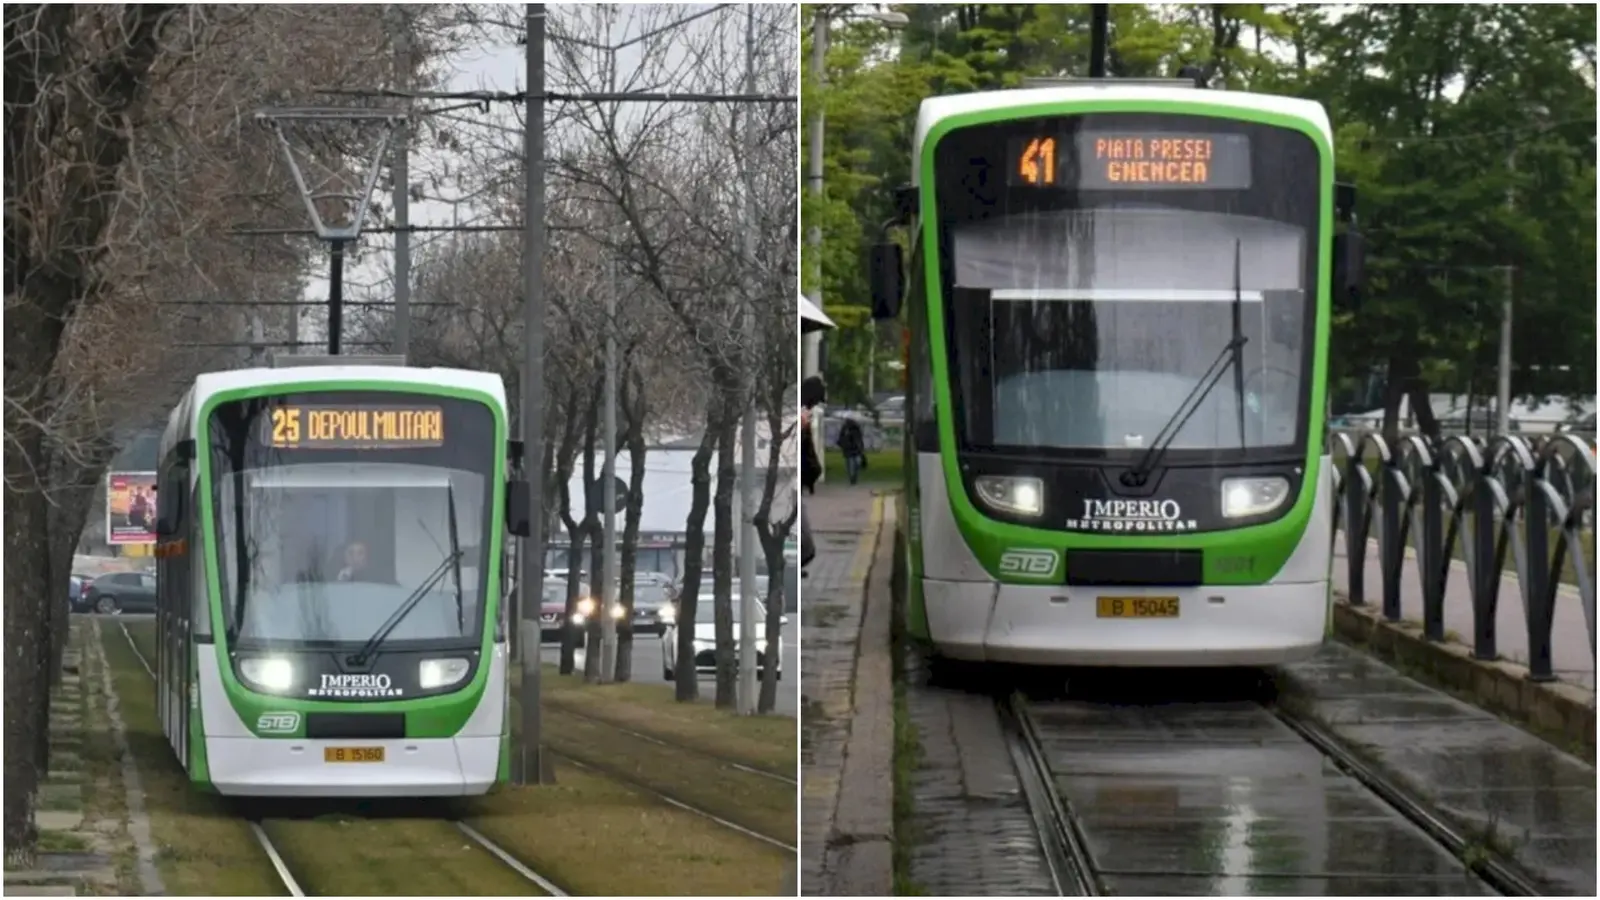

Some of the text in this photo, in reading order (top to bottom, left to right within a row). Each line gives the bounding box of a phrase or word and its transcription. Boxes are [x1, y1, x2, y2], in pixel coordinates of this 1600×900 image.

[1096, 139, 1212, 160] PIATA PRESEI
[1020, 137, 1056, 183] 41
[1107, 161, 1207, 182] GHENCEA
[272, 409, 443, 443] 25 DEPOUL MILITARI
[1083, 499, 1180, 520] IMPERIO
[1066, 519, 1197, 530] METROPOLITAN
[1000, 552, 1053, 572] STB
[1112, 600, 1179, 616] B 15045
[321, 674, 391, 689] IMPERIO
[308, 688, 403, 696] METROPOLITAN
[257, 715, 296, 728] STB
[336, 748, 344, 760] B
